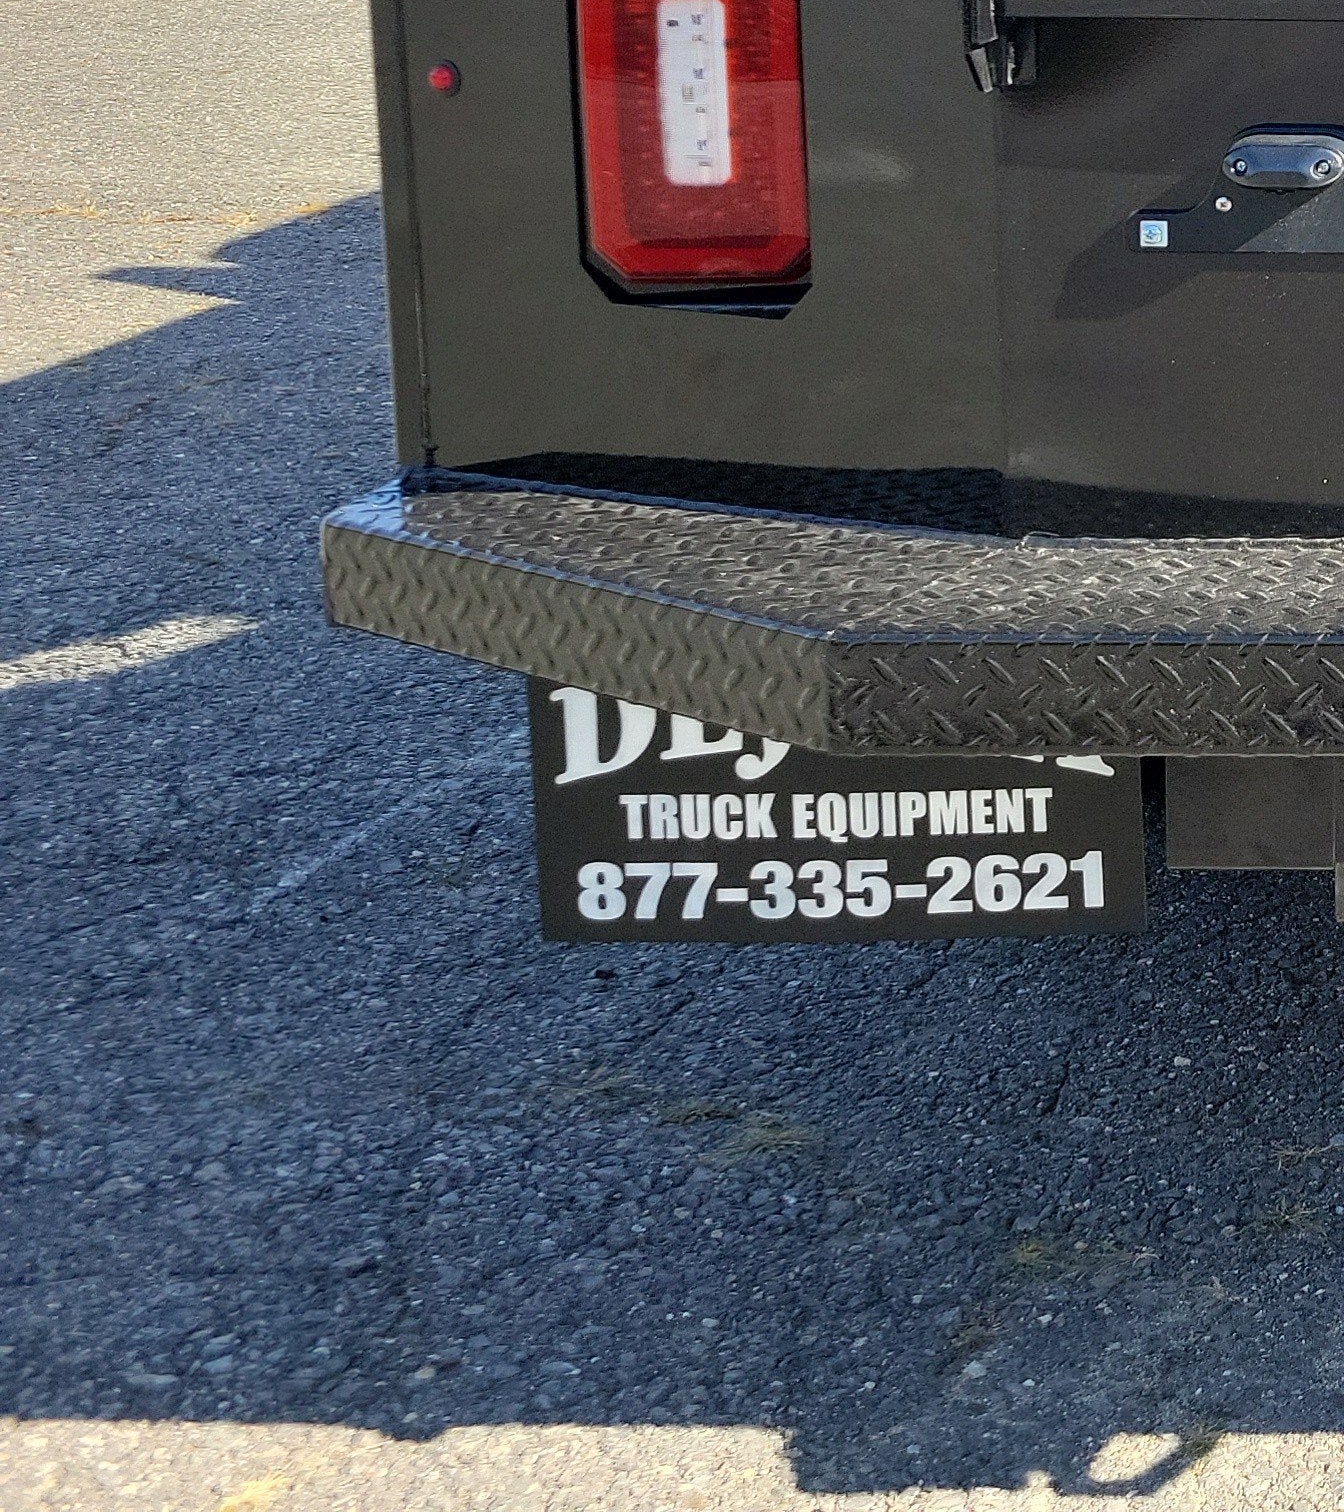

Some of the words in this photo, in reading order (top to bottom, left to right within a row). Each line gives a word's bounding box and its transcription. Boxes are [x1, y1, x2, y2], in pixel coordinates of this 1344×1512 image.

[618, 792, 778, 840] TRUCK
[791, 787, 1053, 843] EQUIPMENT
[577, 850, 1105, 920] 877-335-2621
